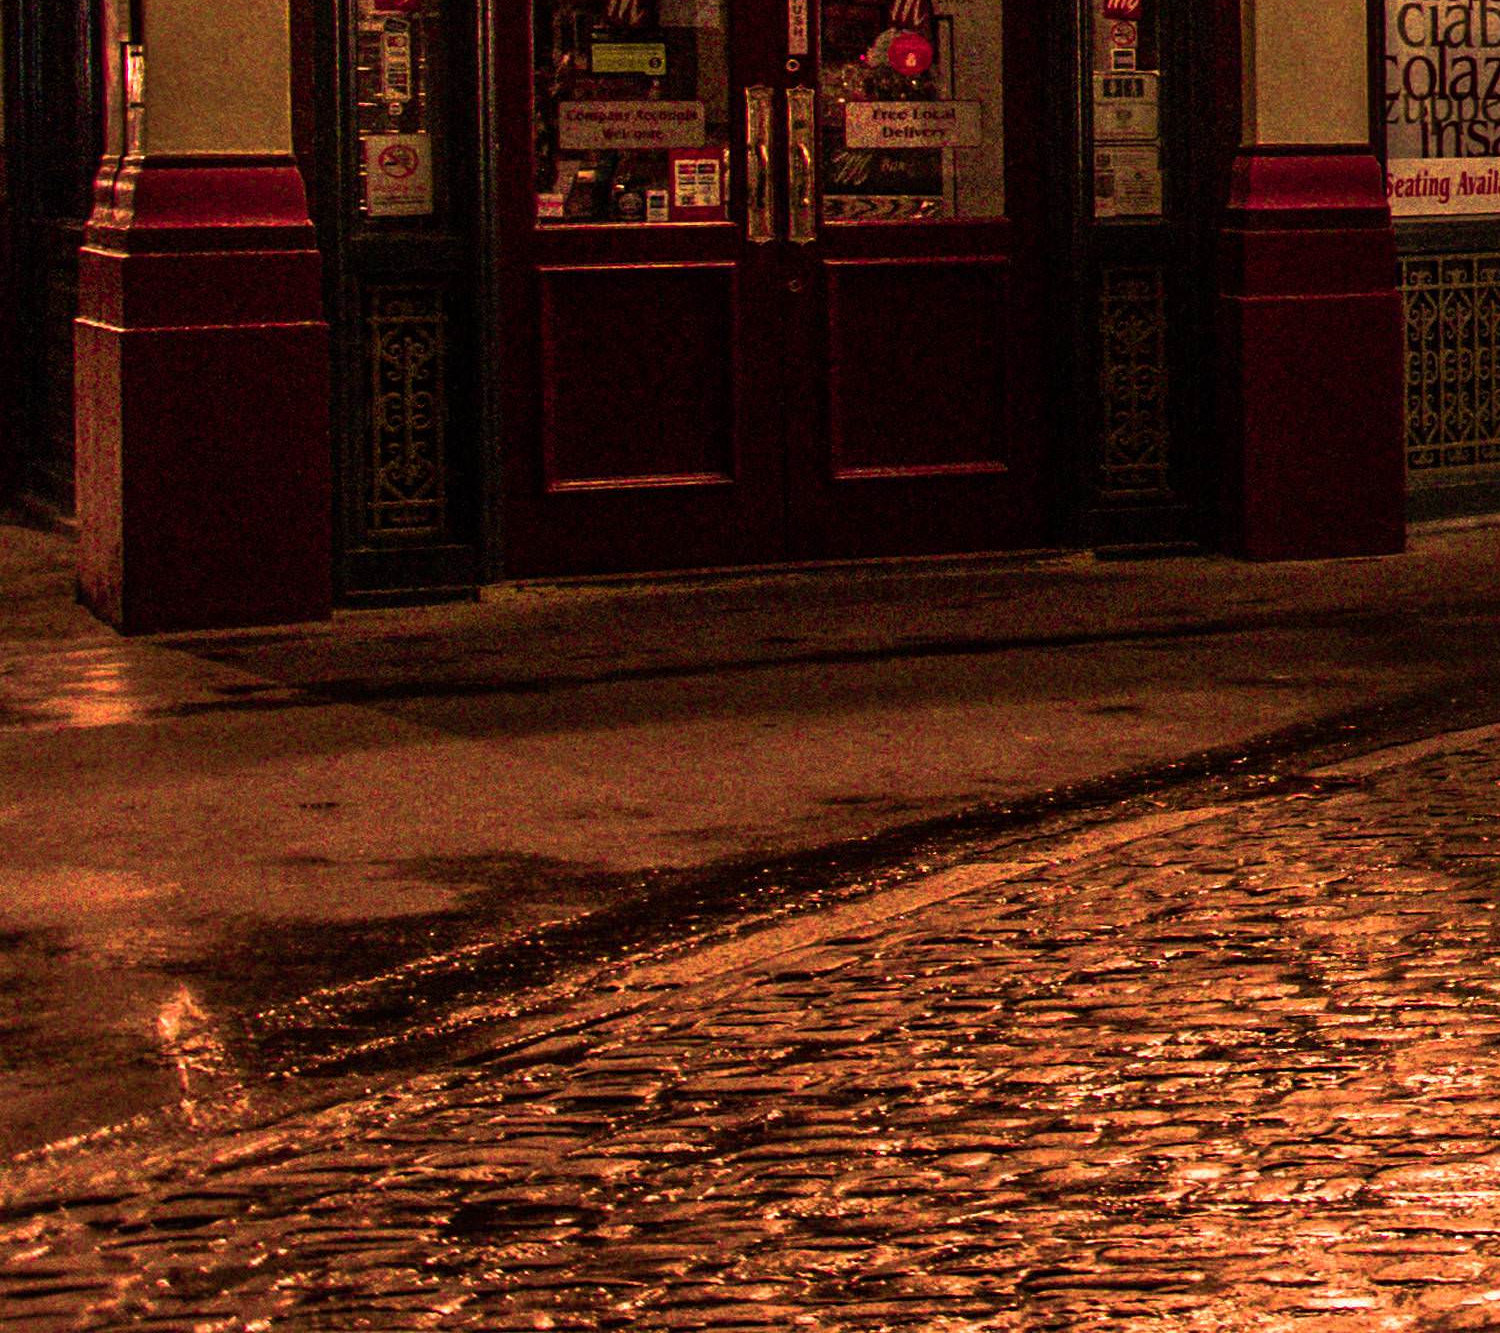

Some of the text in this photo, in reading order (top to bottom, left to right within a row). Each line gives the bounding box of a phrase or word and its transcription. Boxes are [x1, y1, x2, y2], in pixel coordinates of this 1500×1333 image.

[871, 106, 957, 121] Free Local
[881, 125, 948, 140] Delivery
[1386, 172, 1451, 203] Seating
